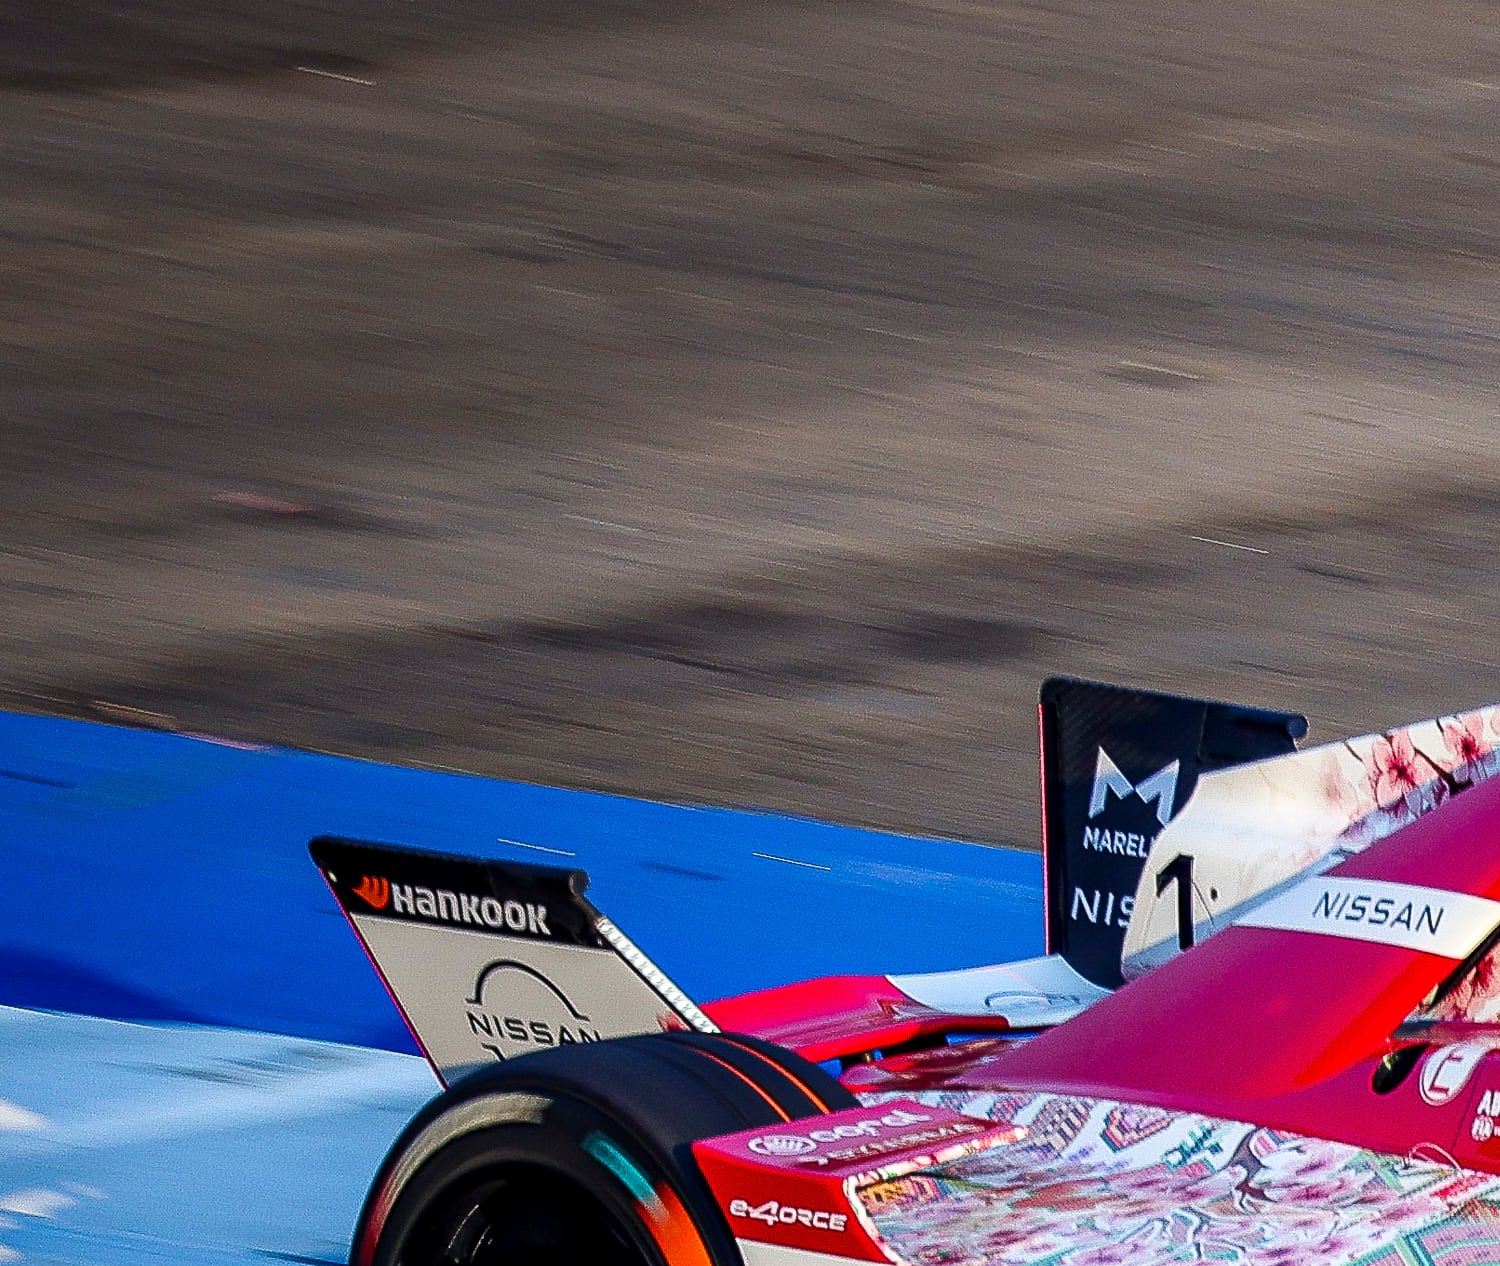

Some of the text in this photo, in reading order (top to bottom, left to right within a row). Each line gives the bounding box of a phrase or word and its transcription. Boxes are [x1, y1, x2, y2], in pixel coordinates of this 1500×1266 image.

[1071, 886, 1135, 929] NIS
[1156, 854, 1194, 951] 1
[1313, 891, 1444, 935] NISSAN
[466, 1010, 601, 1046] NISSAN
